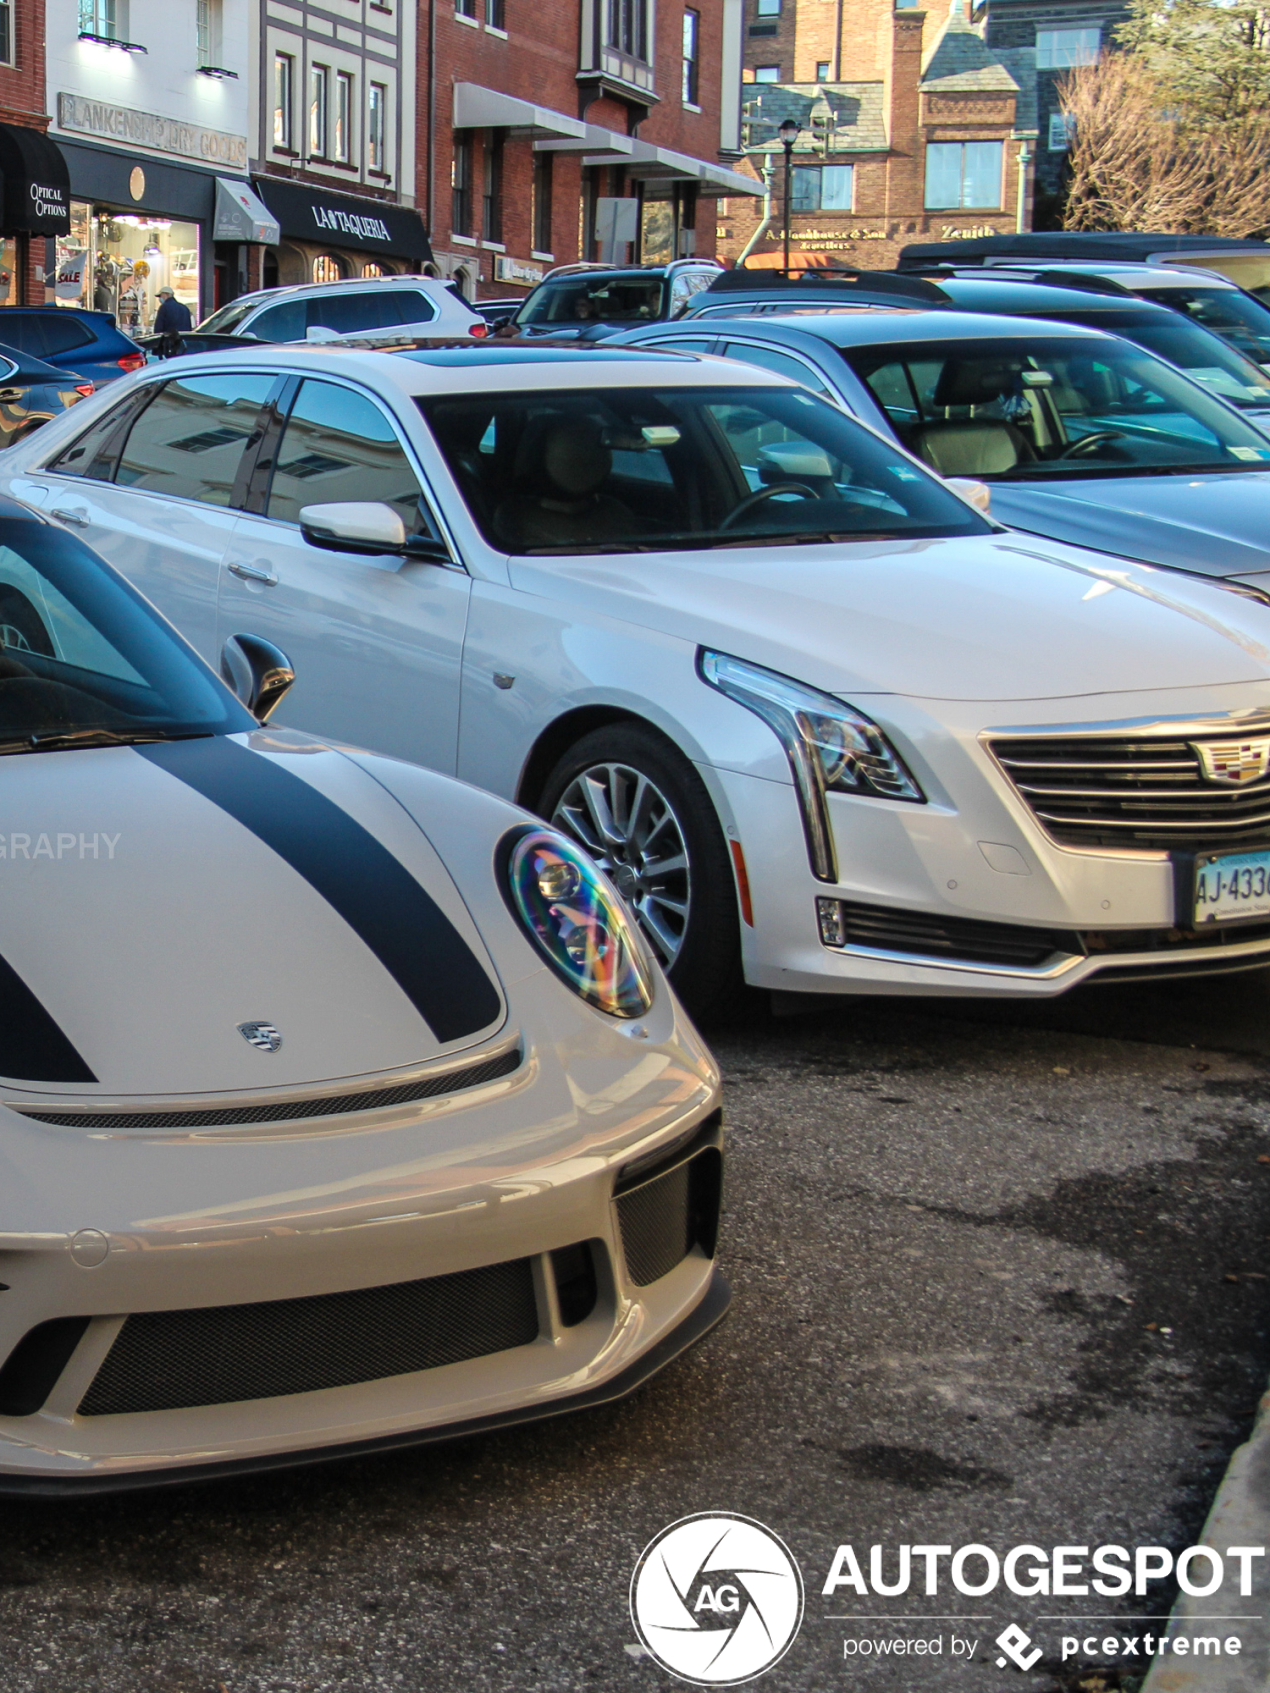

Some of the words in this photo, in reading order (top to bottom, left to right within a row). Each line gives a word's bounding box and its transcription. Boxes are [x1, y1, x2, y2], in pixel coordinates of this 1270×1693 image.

[61, 96, 165, 138] BLANKENSHIP
[169, 123, 196, 151] DRY
[200, 131, 246, 164] GOODS
[30, 183, 63, 201] OPTICAL
[35, 199, 67, 217] OPTIONS
[311, 206, 331, 229] LA
[334, 210, 392, 242] TAQUERIA
[940, 225, 995, 240] Zenith
[57, 271, 81, 284] SALE
